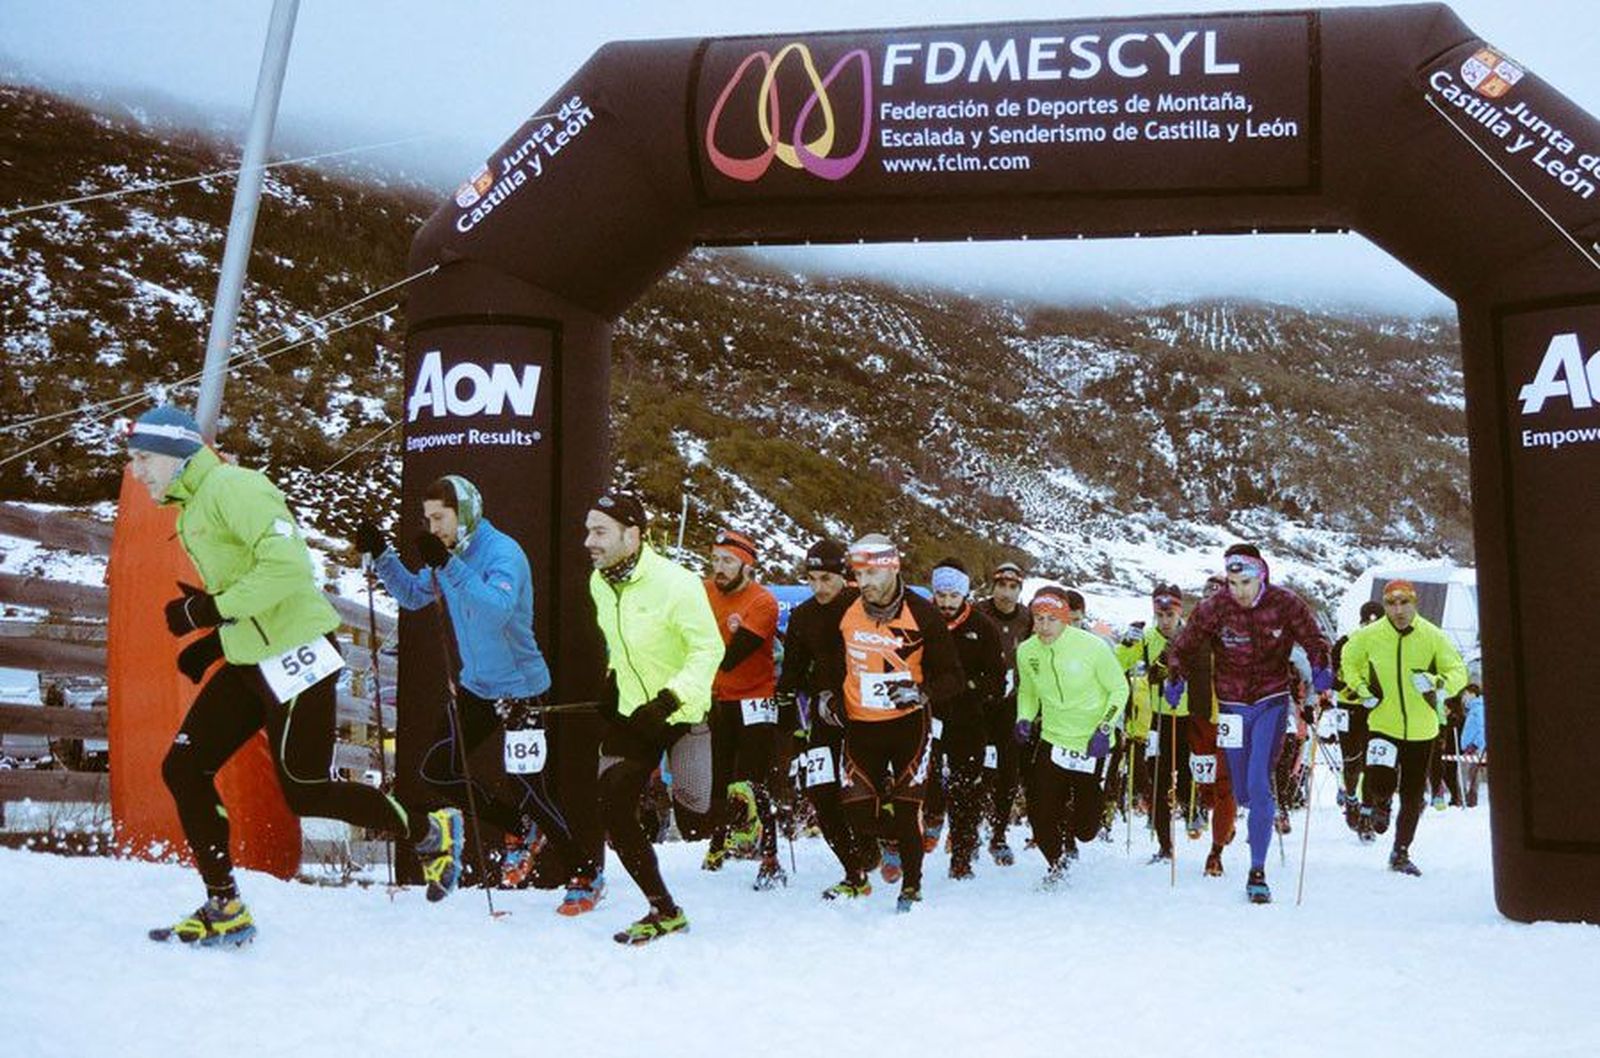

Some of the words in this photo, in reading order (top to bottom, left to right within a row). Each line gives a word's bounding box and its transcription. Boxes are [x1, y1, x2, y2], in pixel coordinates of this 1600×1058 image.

[879, 30, 1240, 86] FDMESCYL
[880, 98, 990, 121] Federación
[995, 97, 1022, 117] de
[1026, 96, 1119, 119] Deportes
[1124, 93, 1151, 114] de
[1156, 91, 1254, 115] Montaña,
[501, 122, 554, 175] Junta
[557, 95, 582, 122] de
[880, 126, 966, 148] Escalada
[970, 129, 983, 150] y
[988, 123, 1107, 146] Senderismo
[1112, 121, 1139, 141] de
[1144, 118, 1221, 141] Castilla
[1226, 123, 1240, 144] y
[1246, 117, 1298, 138] León
[1429, 70, 1512, 139] Castilla
[1505, 132, 1535, 154] y
[1532, 145, 1596, 199] León
[1504, 101, 1575, 155] Junta
[456, 168, 528, 234] Castilla
[527, 153, 543, 176] y
[542, 106, 594, 157] León
[882, 152, 1031, 173] www.fclm.com
[407, 350, 542, 423] AON
[1518, 332, 1600, 415] A
[406, 432, 466, 453] Empower
[1522, 427, 1600, 449] Empow
[281, 645, 317, 676] 56
[506, 741, 540, 760] 184
[806, 756, 826, 773] 27
